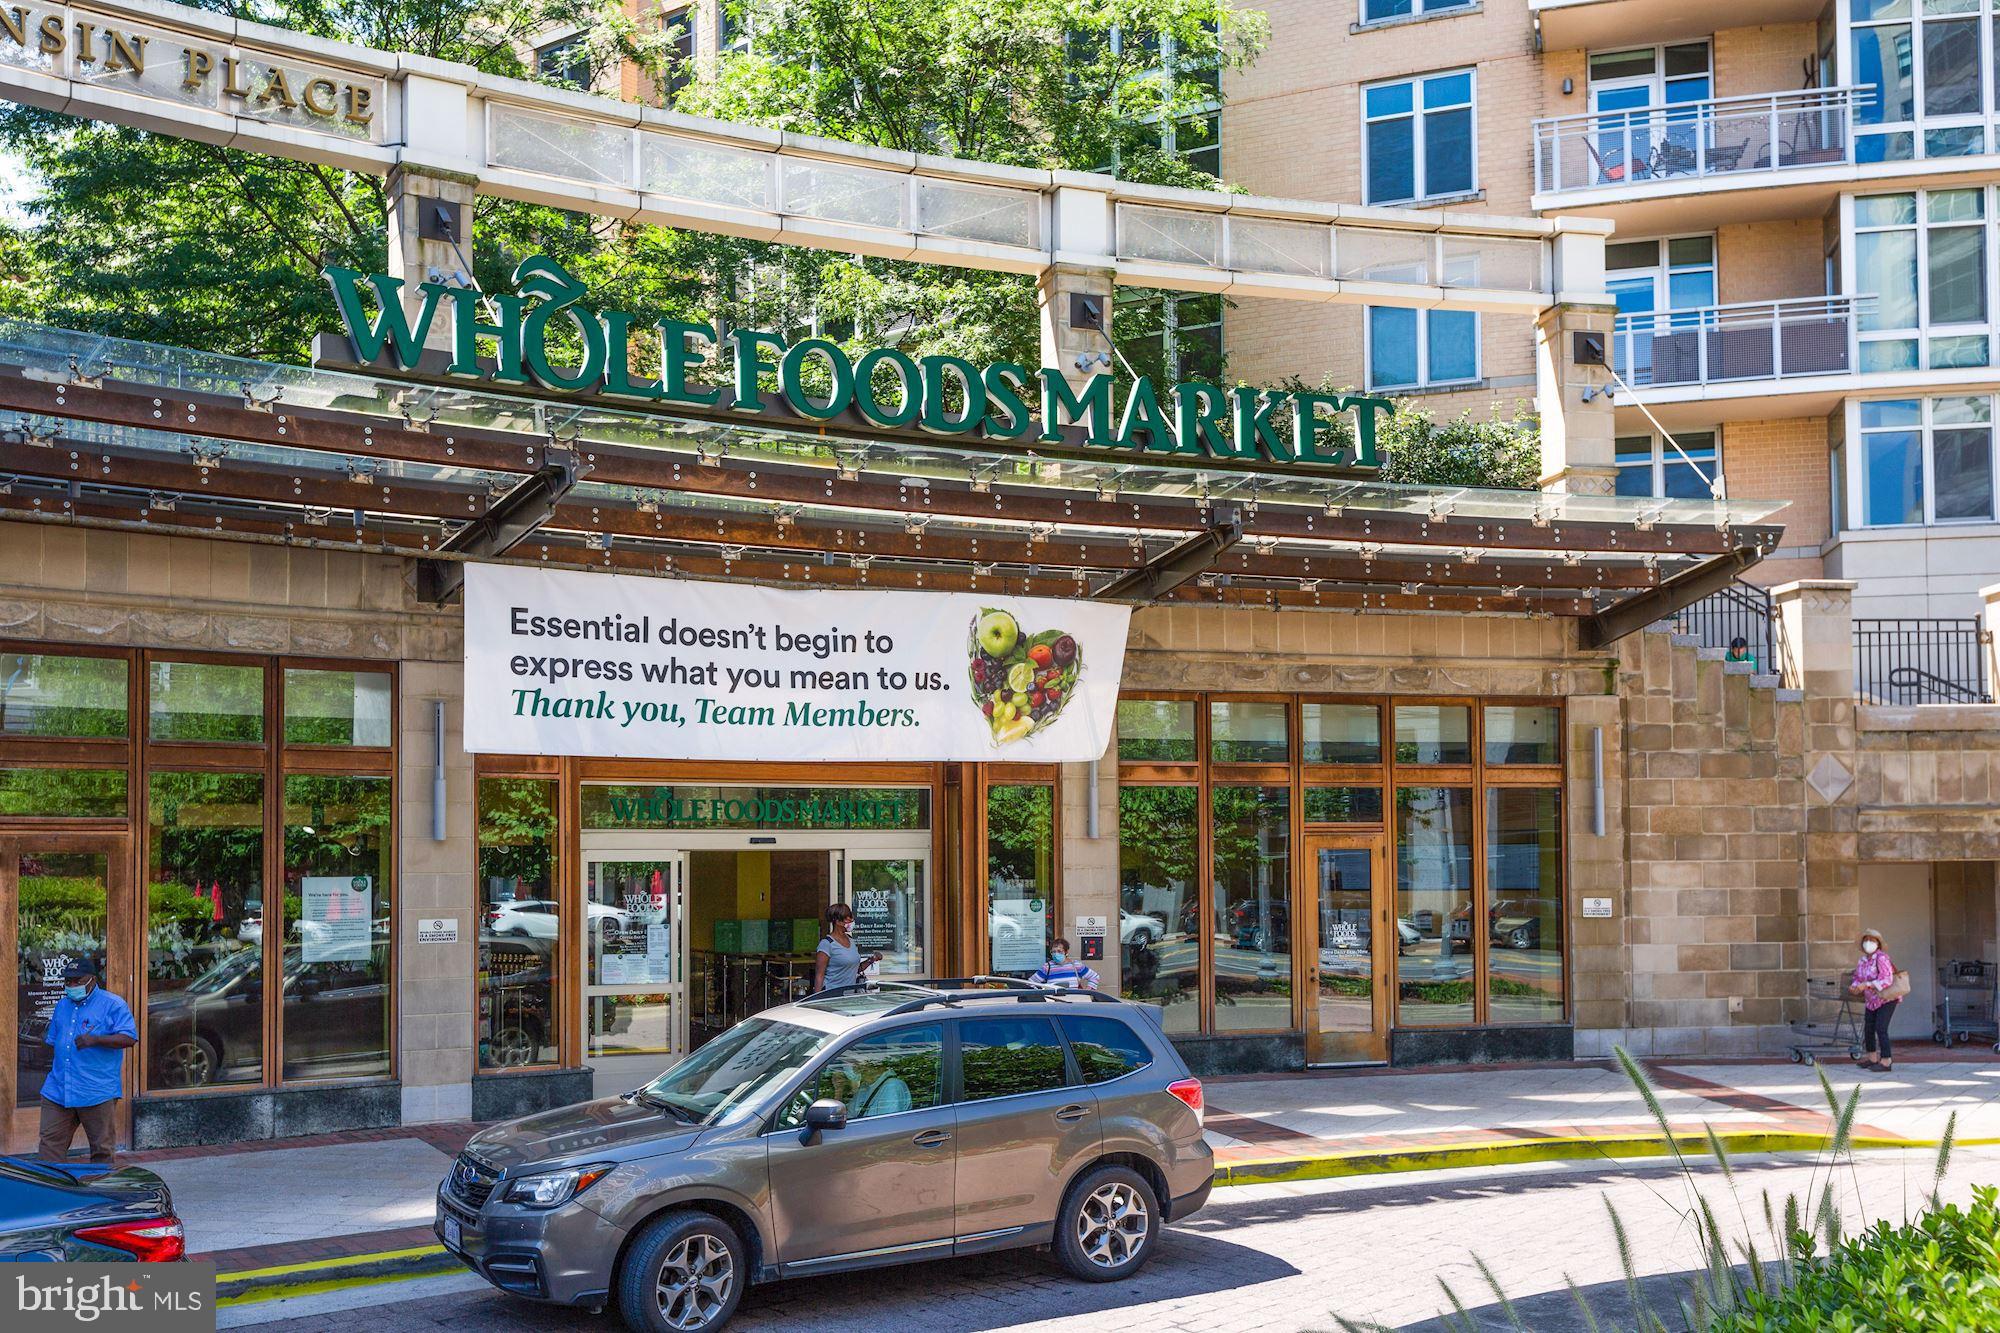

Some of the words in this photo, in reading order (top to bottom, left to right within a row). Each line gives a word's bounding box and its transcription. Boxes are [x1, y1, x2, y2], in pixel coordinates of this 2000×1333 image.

[183, 47, 374, 124] PLACE
[319, 254, 721, 406] WHOLE
[728, 329, 1031, 440] FOODS
[1035, 366, 1394, 469] MARKET
[510, 606, 649, 643] Essential
[658, 618, 767, 651] doesn't
[775, 625, 857, 659] begin
[865, 630, 893, 653] to
[510, 653, 633, 683] express
[641, 657, 718, 687] what
[727, 666, 780, 693] you
[790, 669, 869, 690] mean
[877, 667, 907, 690] to
[914, 670, 950, 691] us.
[511, 688, 614, 719] Thank
[620, 698, 687, 728] you,
[695, 698, 776, 727] Team
[783, 700, 920, 728] Members.
[610, 787, 707, 823] WHOLE
[711, 798, 795, 823] FOODS
[799, 798, 907, 824] MARKET
[624, 890, 663, 904] WHOLE
[856, 887, 890, 899] WHOLE
[858, 899, 888, 908] FOODS
[1332, 921, 1357, 930] WHOLE
[1333, 930, 1356, 938] FOODS
[42, 954, 73, 967] WHO
